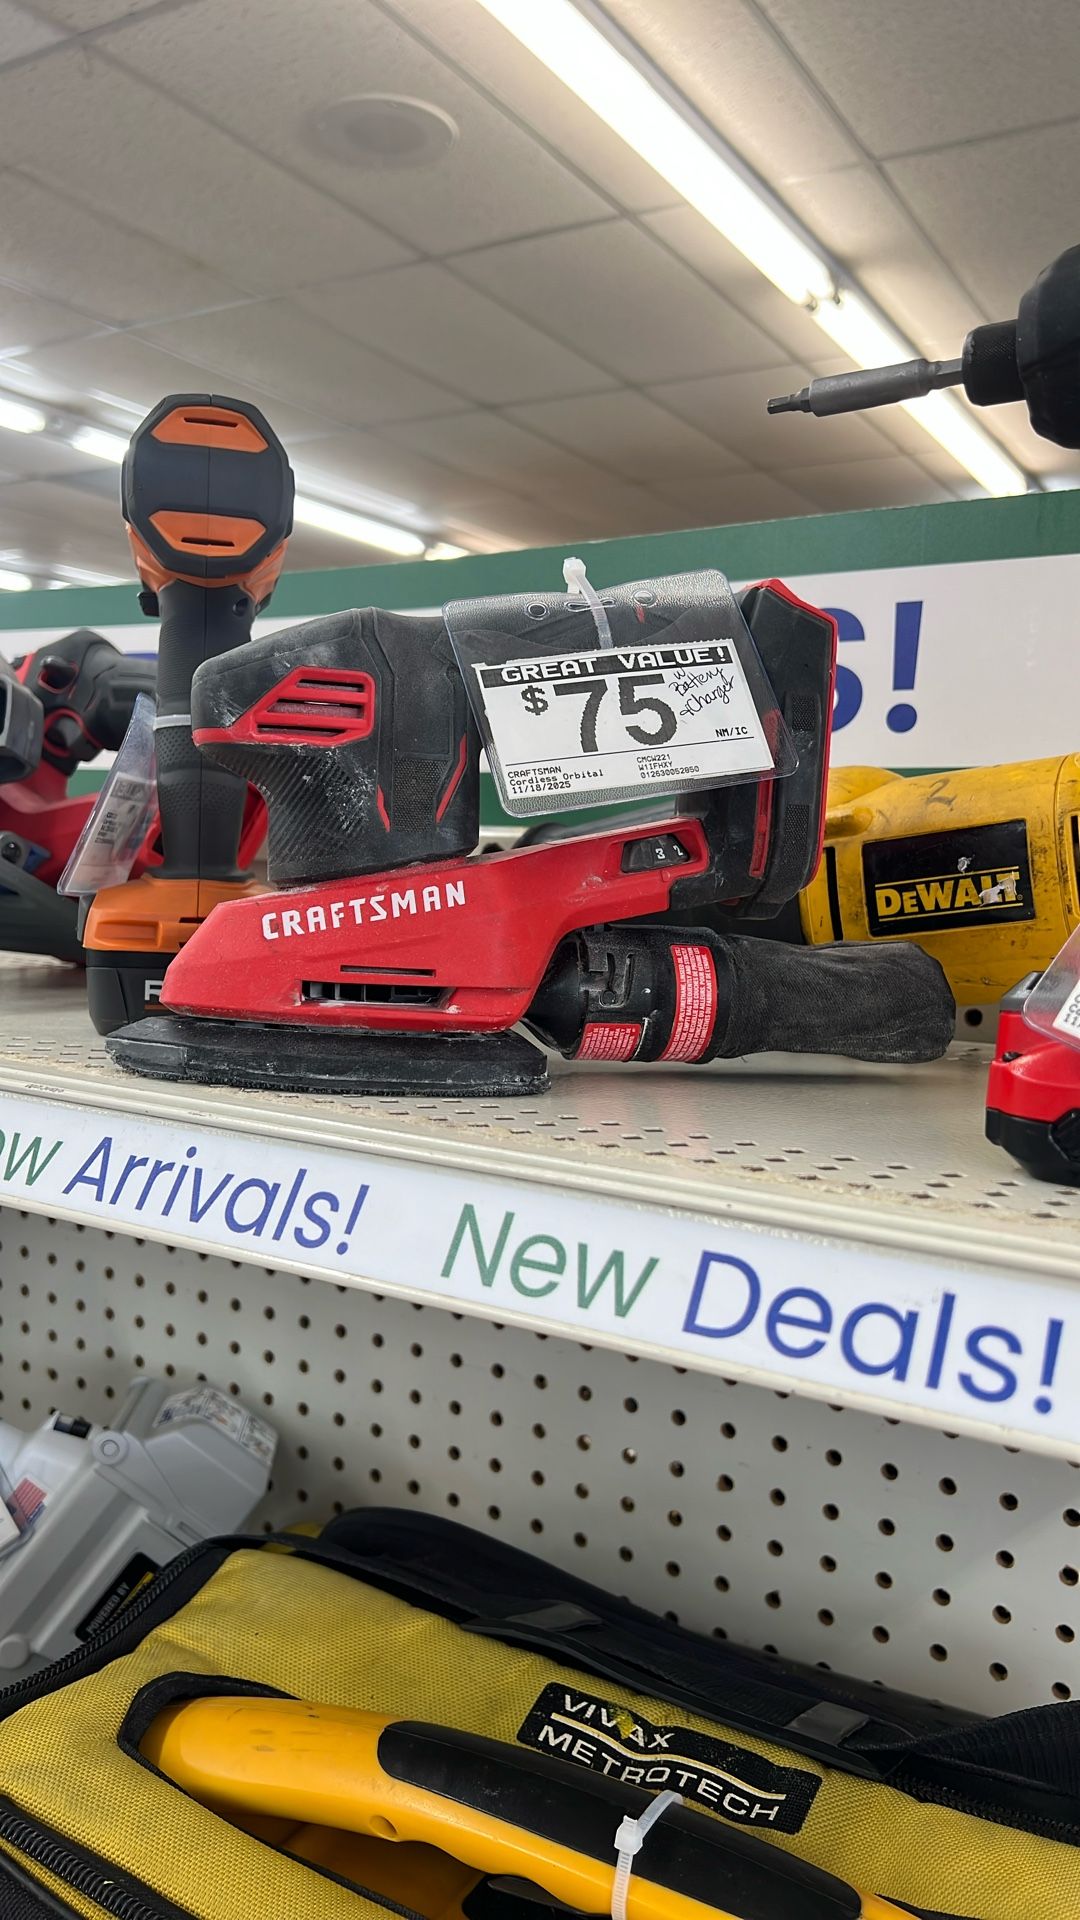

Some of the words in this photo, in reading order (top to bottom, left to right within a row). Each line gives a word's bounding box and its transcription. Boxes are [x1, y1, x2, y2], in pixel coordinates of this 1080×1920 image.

[501, 657, 597, 682] GREAT
[617, 646, 726, 669] VALUE!
[716, 726, 748, 738] NM/IC
[637, 754, 670, 763] CMCW221
[508, 766, 562, 779] CRAFTSMAN
[510, 775, 557, 786] Cordless
[563, 769, 604, 780] Orbital
[512, 781, 571, 794] 11/18/2025
[655, 848, 666, 859] 3
[261, 880, 466, 940] CRAFTSMAN
[0, 1128, 64, 1187] w
[61, 1136, 371, 1256] Arrivals!
[440, 1203, 660, 1318] New
[682, 1250, 1065, 1414] Deals!
[538, 1725, 780, 1821] METROTECH
